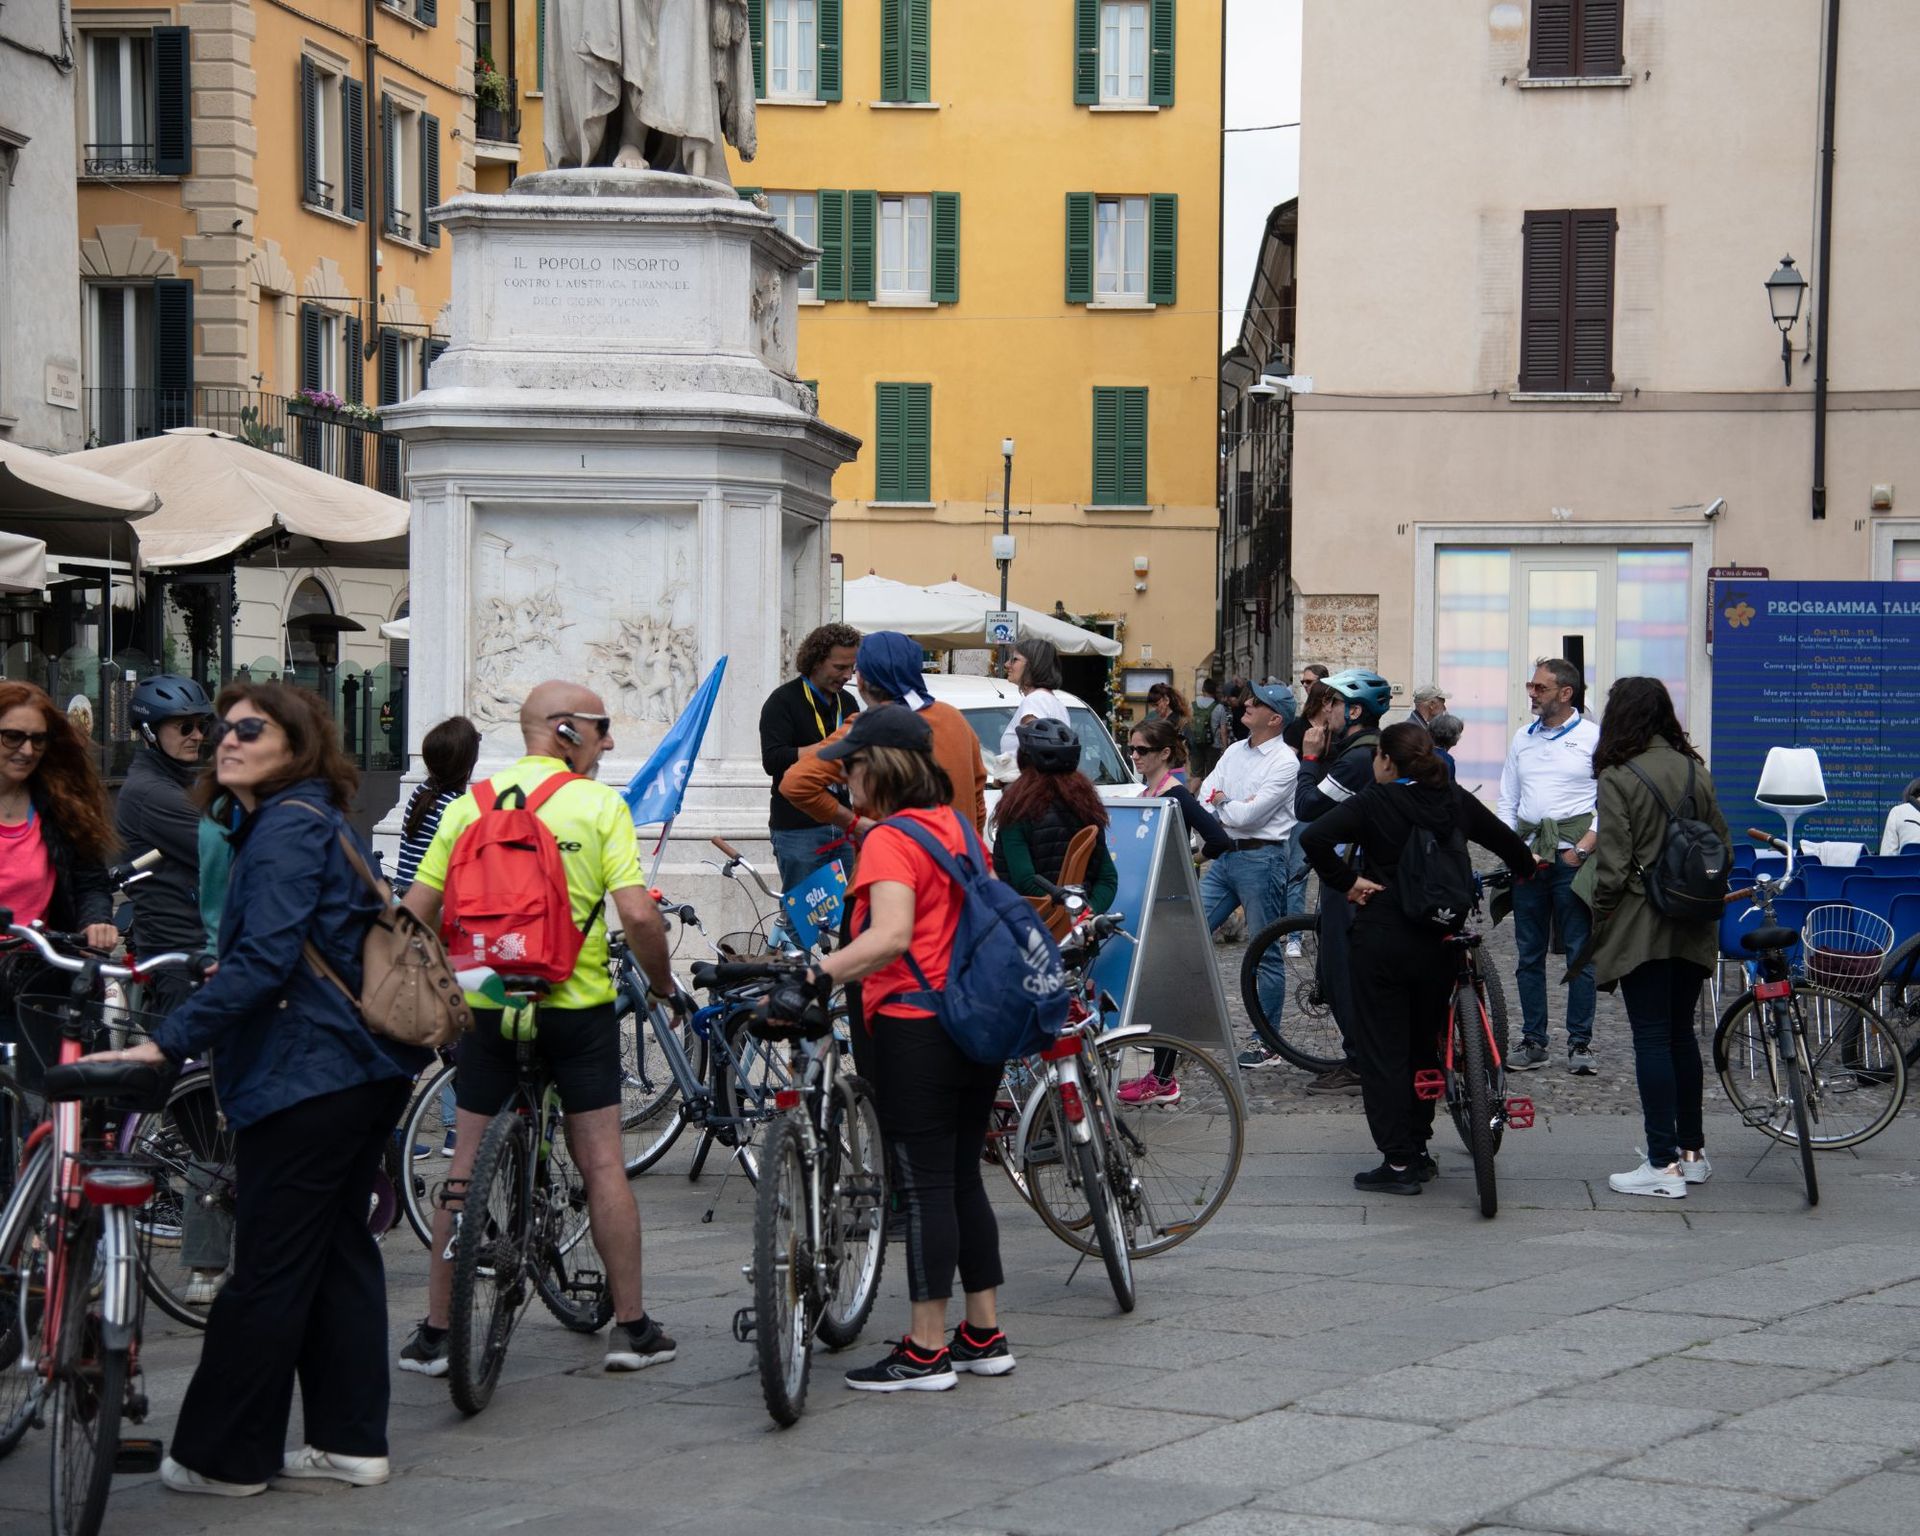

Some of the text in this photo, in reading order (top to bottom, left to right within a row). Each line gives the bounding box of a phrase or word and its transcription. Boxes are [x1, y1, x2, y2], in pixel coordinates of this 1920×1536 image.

[513, 257, 680, 271] IL POPOLO INSORTO
[504, 278, 550, 288] CONTRO
[1767, 601, 1878, 614] PROGRAMMA
[1779, 690, 1791, 698] per
[1803, 689, 1834, 697] weekend
[1753, 715, 1792, 723] Rimettersi
[805, 887, 828, 908] Blu
